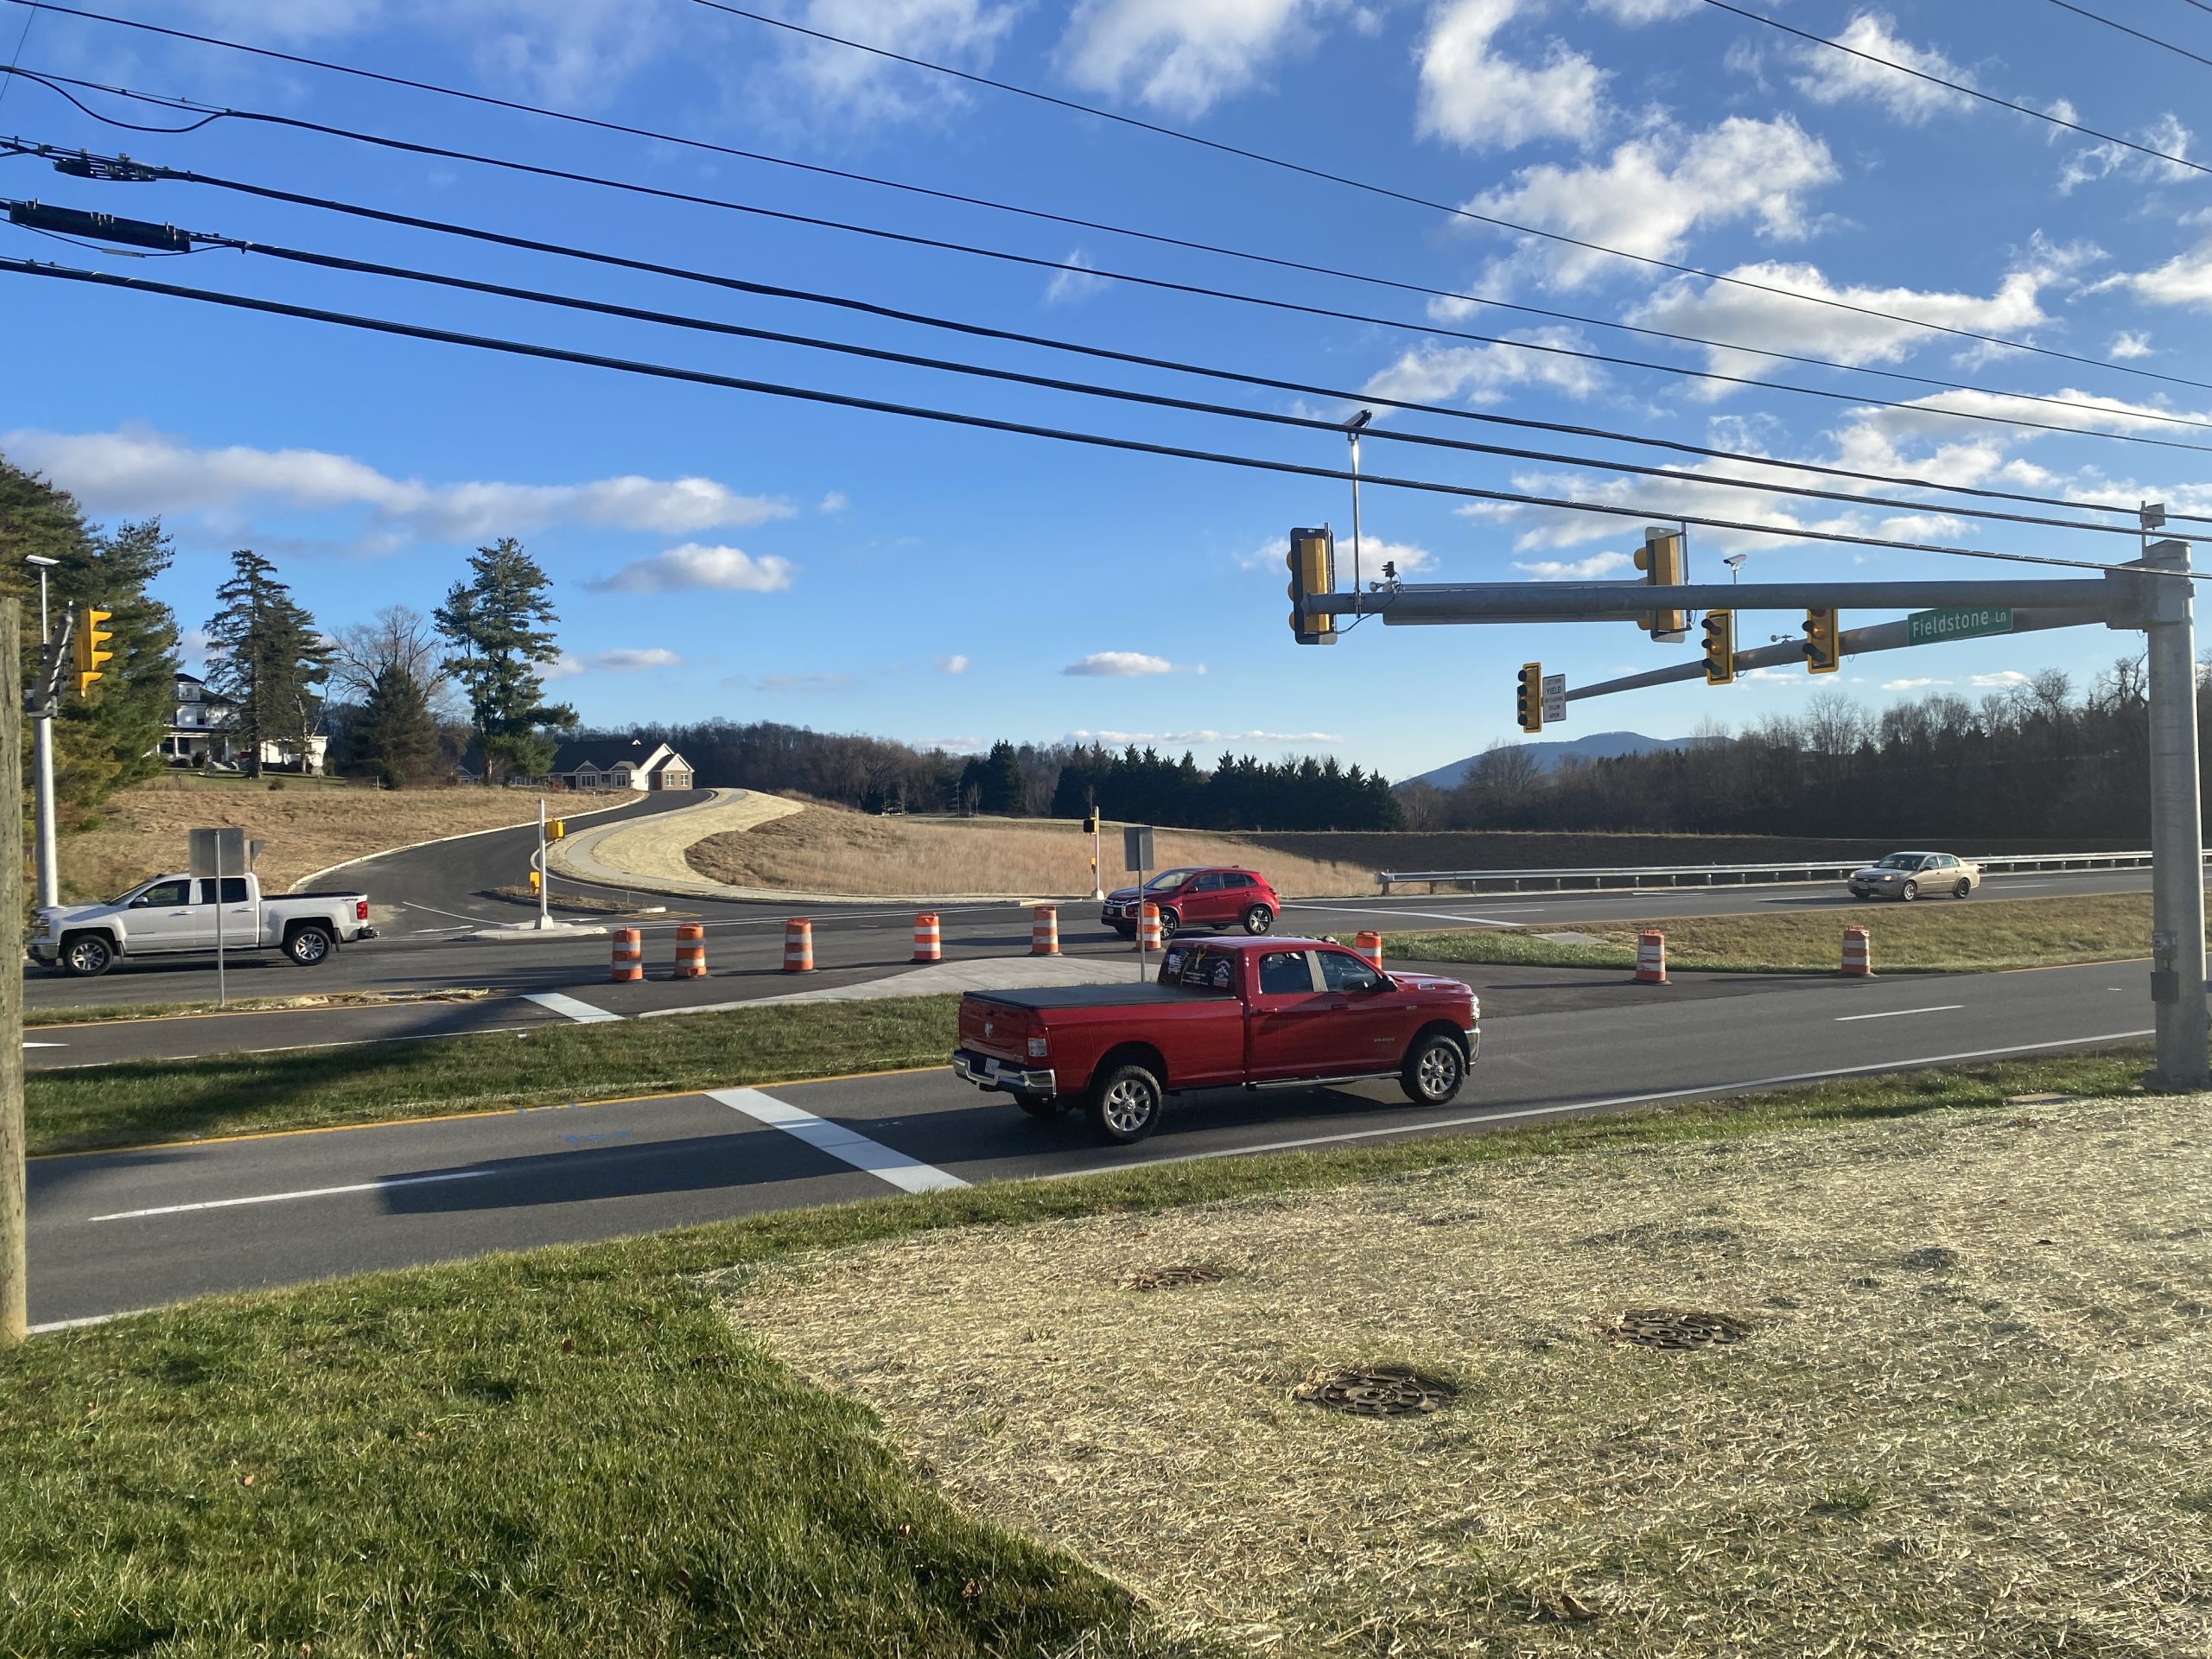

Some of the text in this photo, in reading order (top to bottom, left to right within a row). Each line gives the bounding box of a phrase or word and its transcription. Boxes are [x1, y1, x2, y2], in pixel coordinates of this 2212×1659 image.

[1912, 610, 2006, 638] Fieldstone Ln
[1547, 685, 1561, 695] YIELD
